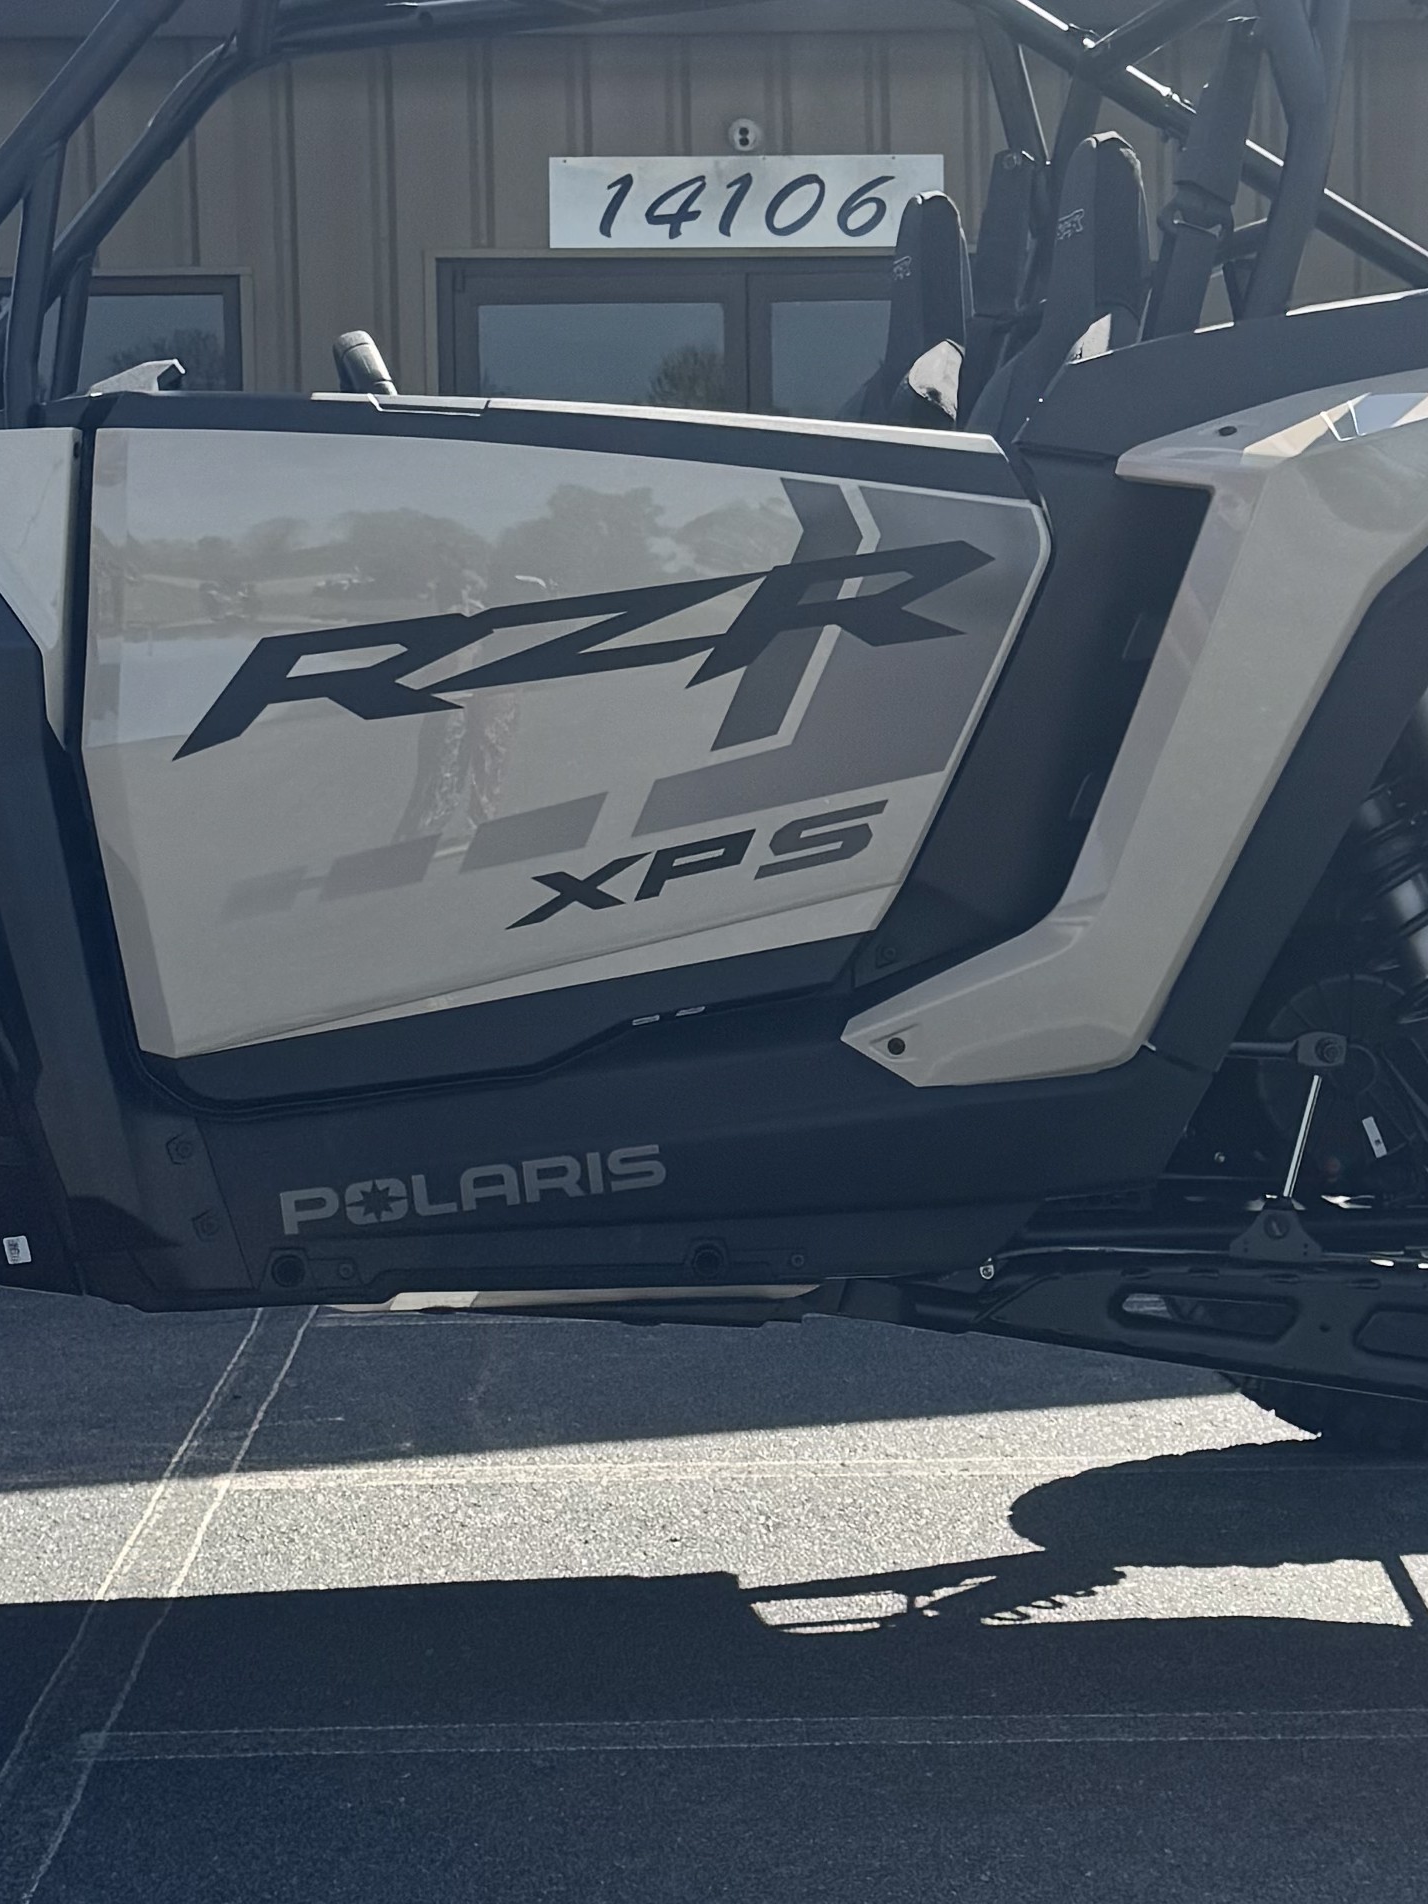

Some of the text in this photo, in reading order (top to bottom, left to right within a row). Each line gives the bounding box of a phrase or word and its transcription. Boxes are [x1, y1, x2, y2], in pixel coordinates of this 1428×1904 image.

[598, 172, 896, 240] 14106
[171, 539, 996, 763] RZR
[504, 798, 889, 931] XPS
[279, 1144, 667, 1235] POLARIS
